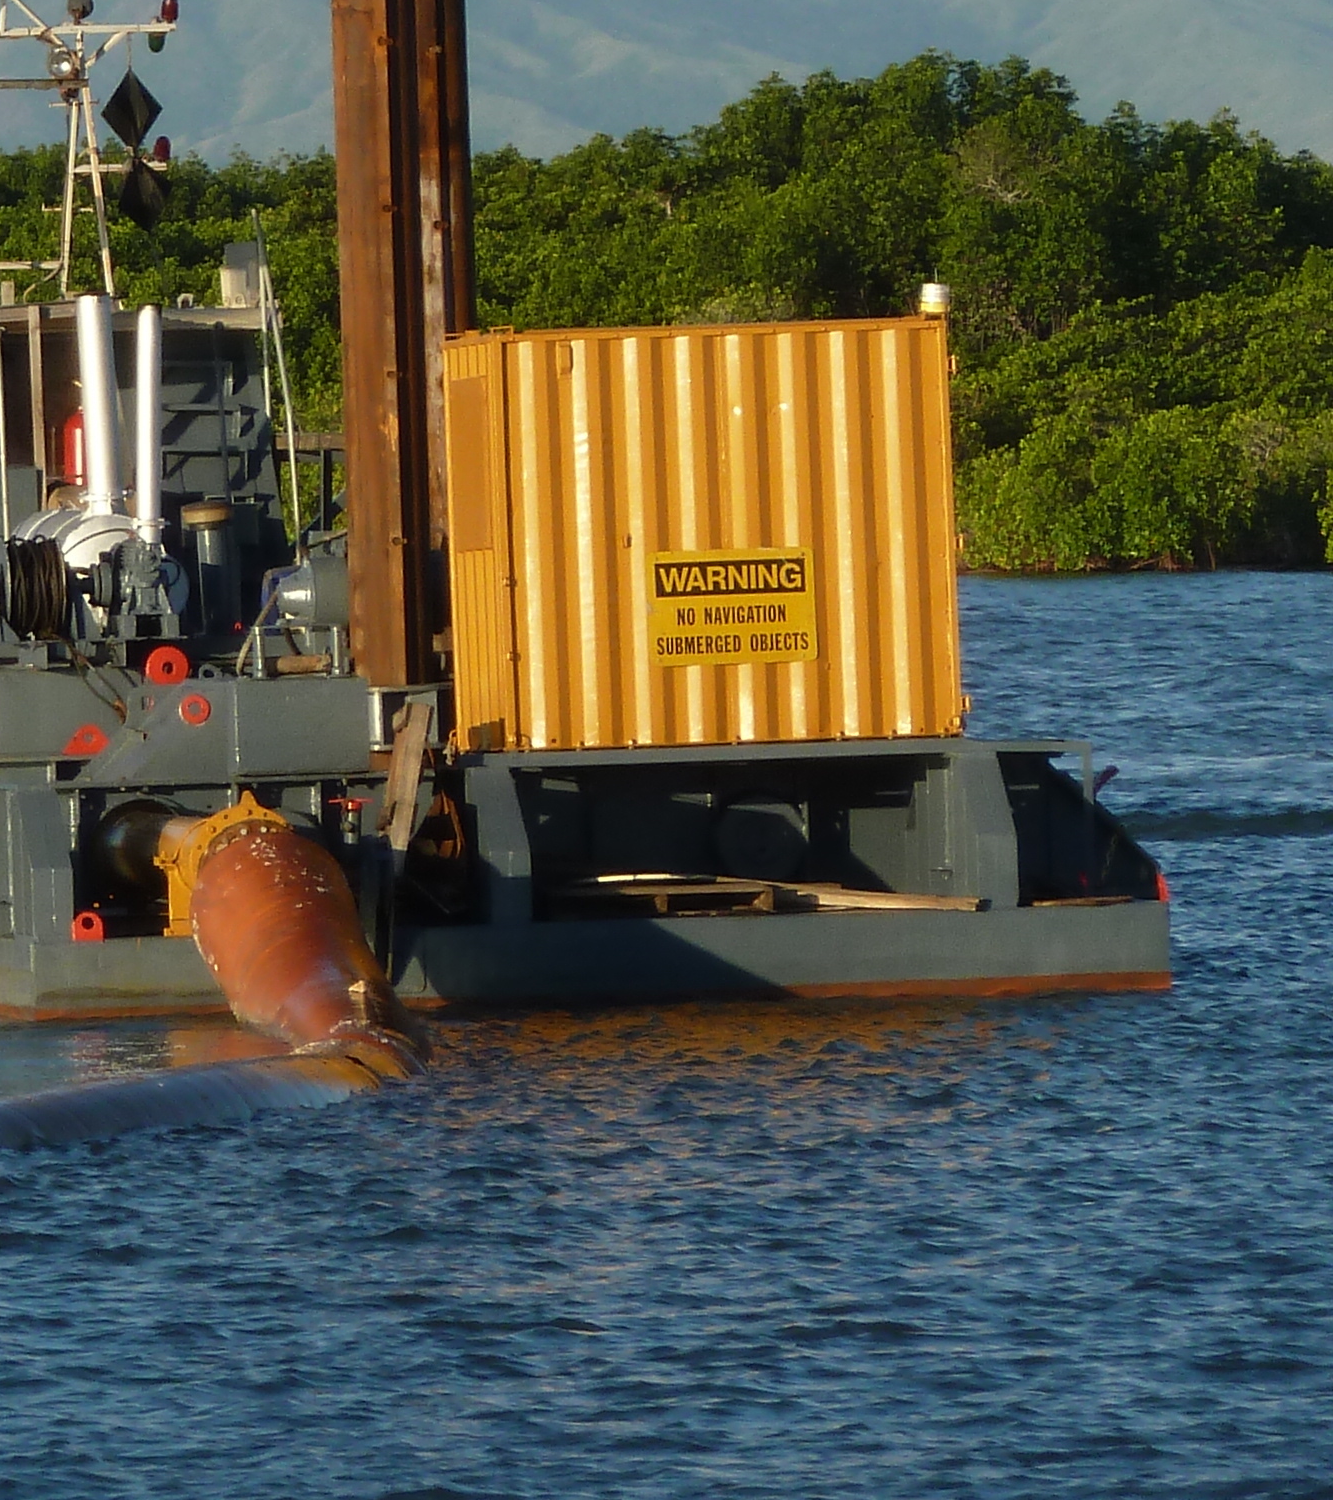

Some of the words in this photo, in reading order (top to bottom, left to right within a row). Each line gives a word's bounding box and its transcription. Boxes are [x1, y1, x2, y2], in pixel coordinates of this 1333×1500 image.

[659, 562, 802, 593] WARNING
[677, 607, 696, 626] NO
[704, 604, 787, 625] NAVIGATION
[656, 635, 742, 656] SUBMERGED
[750, 632, 810, 651] OBJECTS
